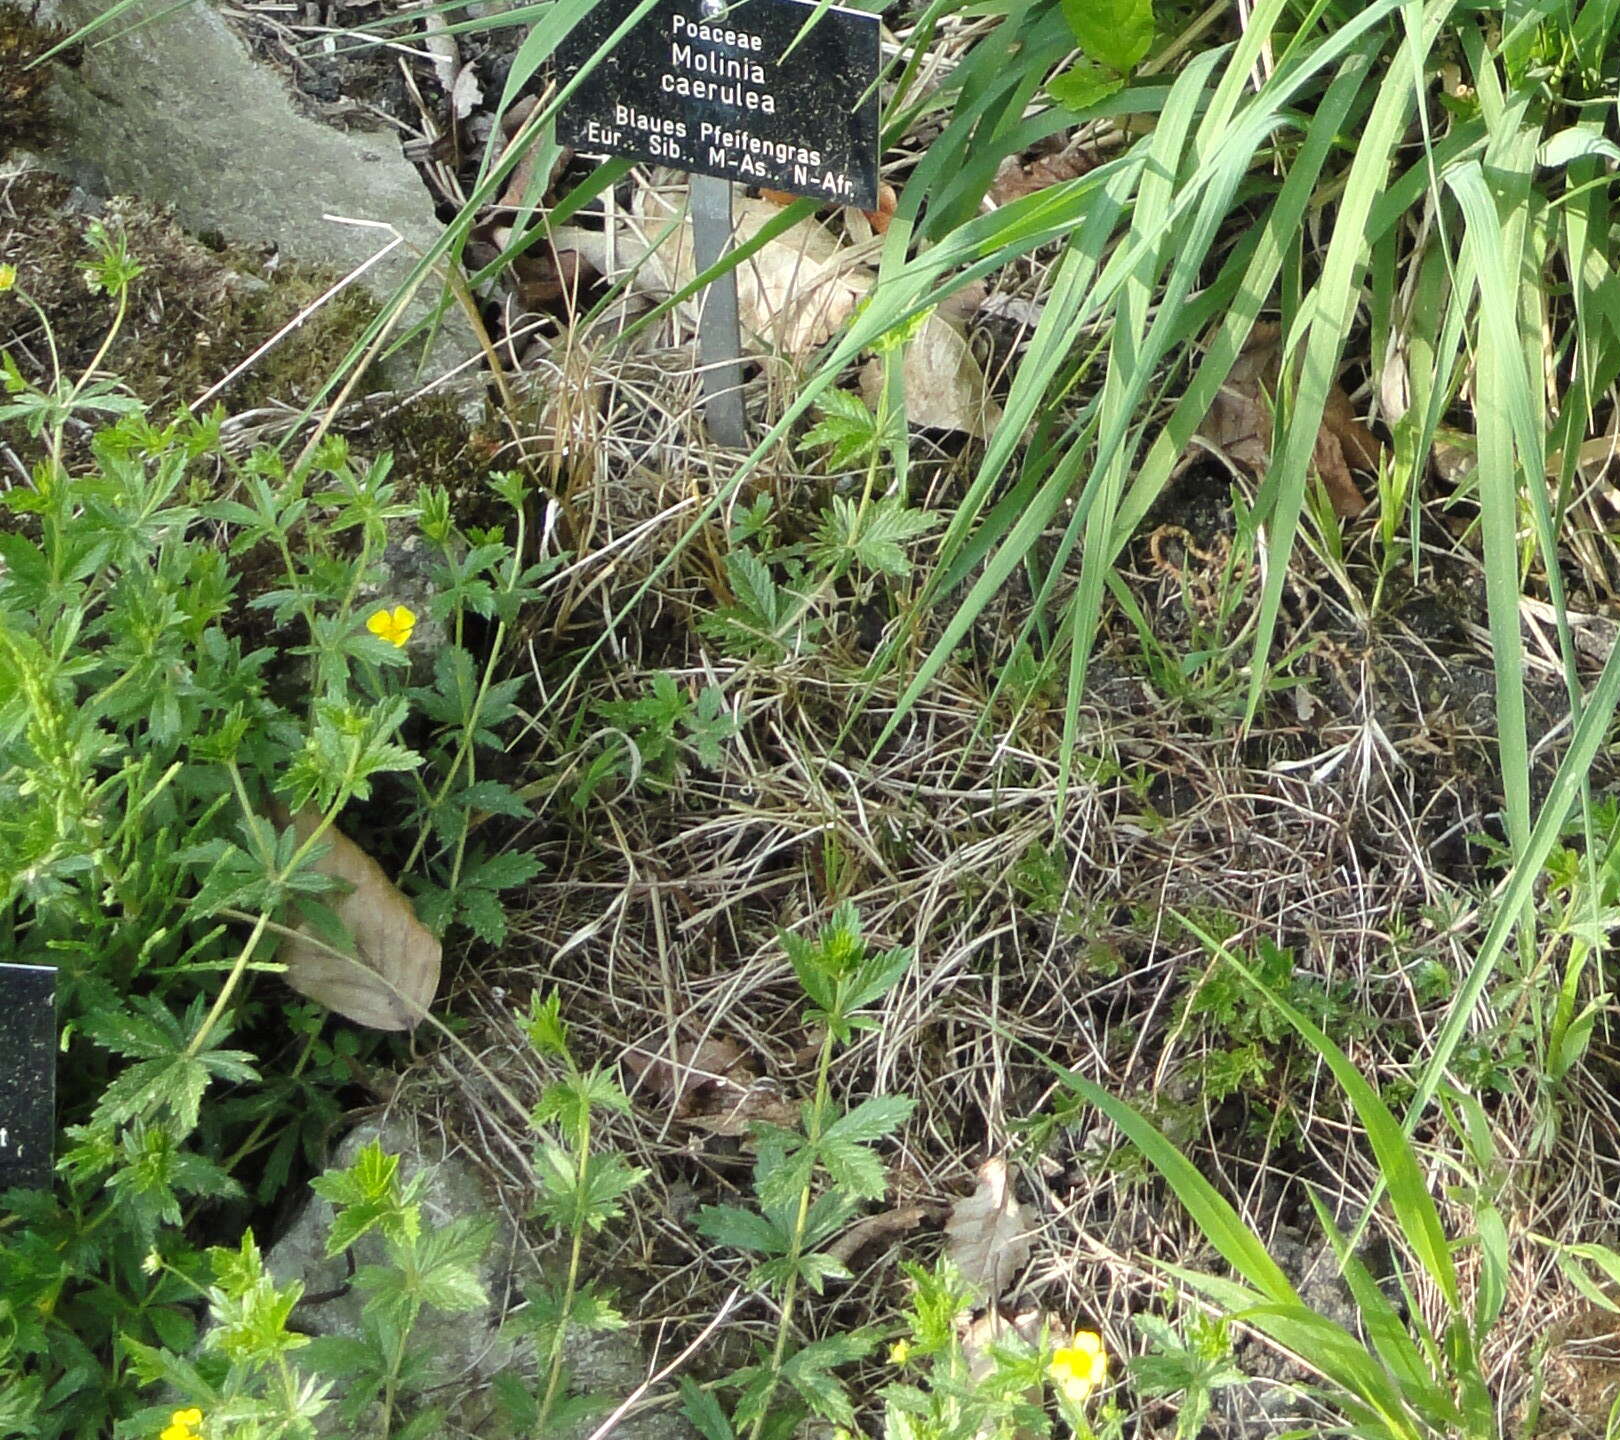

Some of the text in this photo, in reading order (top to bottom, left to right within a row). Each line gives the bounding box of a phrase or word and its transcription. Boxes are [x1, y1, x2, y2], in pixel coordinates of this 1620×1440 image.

[672, 14, 763, 51] Poaceae
[672, 42, 765, 85] Molinia
[661, 73, 776, 113] caerulea
[616, 105, 821, 166] Blaues Pfeifengras
